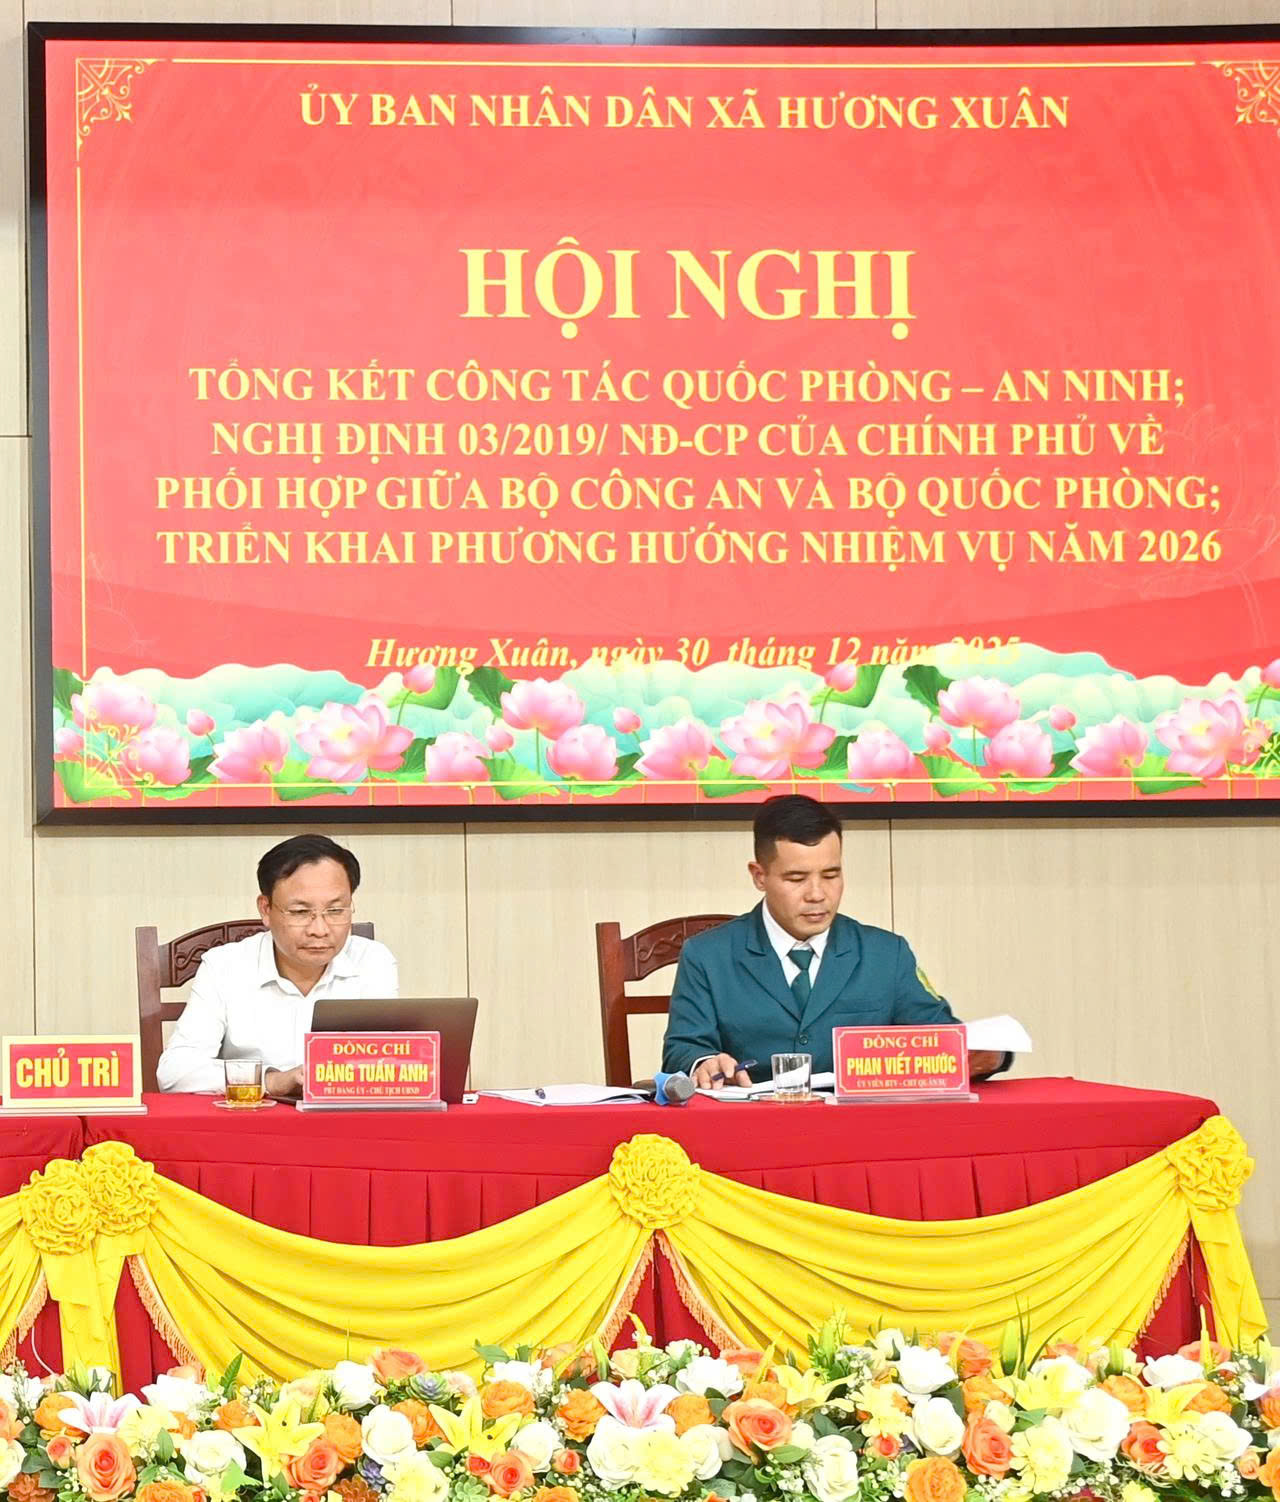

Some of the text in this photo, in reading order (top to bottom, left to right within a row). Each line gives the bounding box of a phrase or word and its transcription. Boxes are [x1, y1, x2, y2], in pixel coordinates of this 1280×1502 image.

[299, 83, 1069, 129] ỦY BAN NHÂN DÂN XÃ HƯƠNG XUÂN
[458, 236, 917, 341] HỘI NGHỊ
[188, 358, 314, 401] TỔNG
[327, 358, 416, 401] KẾT
[425, 359, 552, 402] CÔNG
[562, 359, 650, 402] TÁC
[662, 360, 787, 410] QUỐC
[799, 359, 952, 403] PHÒNG
[992, 369, 1050, 402] AN
[1063, 369, 1185, 407] NINH;
[211, 413, 1164, 465] NGHỊ ĐỊNH 03/2019/ NĐ-CP CỦA CHÍNH PHỦ VỀ
[155, 466, 1220, 519] PHỐI HỢP GIỮA BỘ CÔNG AN VÀ BỘ QUỐC PHÒNG;
[155, 521, 1222, 573] TRIỂN KHAI PHƯƠNG HƯỚNG NHIỆM VỤ NĂM 2026
[485, 637, 578, 671] Xuân,
[677, 638, 709, 666] 30
[826, 637, 862, 665] 12
[333, 1040, 410, 1055] ĐỒNG CHÍ
[911, 1034, 939, 1048] CHÍ
[16, 1047, 119, 1088] CHỦ TRÌ
[316, 1059, 428, 1086] ĐẶNG TUẤN ANH
[847, 1051, 957, 1076] PHAN VIẾT PHƯỚC
